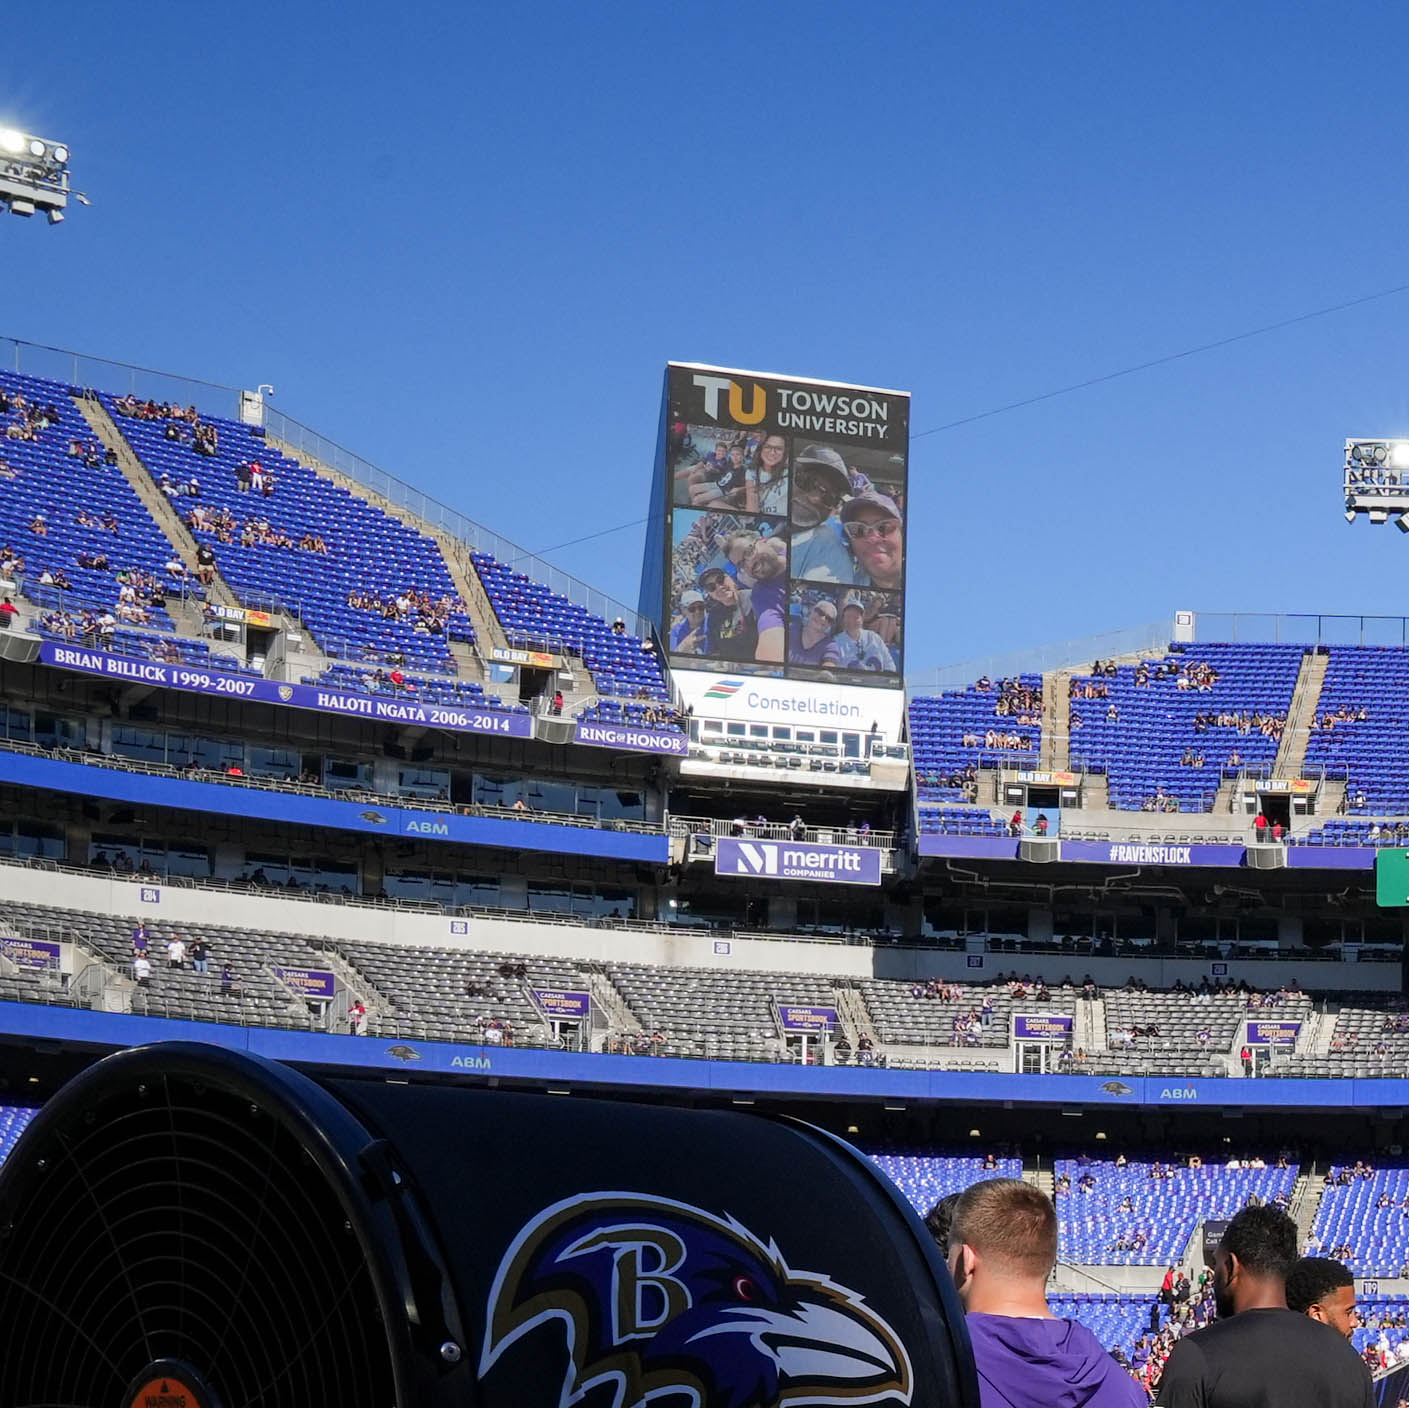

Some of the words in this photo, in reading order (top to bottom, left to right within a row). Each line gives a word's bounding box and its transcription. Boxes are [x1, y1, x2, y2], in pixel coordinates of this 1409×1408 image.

[693, 374, 767, 425] TU
[777, 388, 888, 420] TOWSON
[777, 412, 889, 439] UNIVERSITY
[226, 610, 245, 621] BAY
[493, 648, 509, 660] OLD
[511, 650, 529, 662] BAY
[55, 648, 103, 666] BRIAN
[107, 657, 166, 682] BILLICK
[172, 670, 255, 695] 1999-2007
[318, 693, 372, 714] HALOTI
[377, 701, 426, 721] NGATA
[431, 710, 510, 731] 2006-2014
[747, 692, 860, 718] Constellation
[581, 727, 617, 742] RING
[626, 733, 682, 751] HONOR
[1017, 772, 1031, 782] OLD
[1032, 773, 1052, 783] BAY
[1255, 780, 1269, 791] OLD
[1271, 780, 1288, 791] BAY
[406, 820, 449, 836] ABM
[783, 850, 862, 872] merritt
[1109, 845, 1191, 864] #RAVENSFLOCK
[783, 868, 836, 879] COMPANIES
[540, 992, 565, 1000] CAESARS
[451, 1056, 491, 1069] ABM
[1160, 1088, 1197, 1099] ABM
[144, 1395, 186, 1408] WARNING
